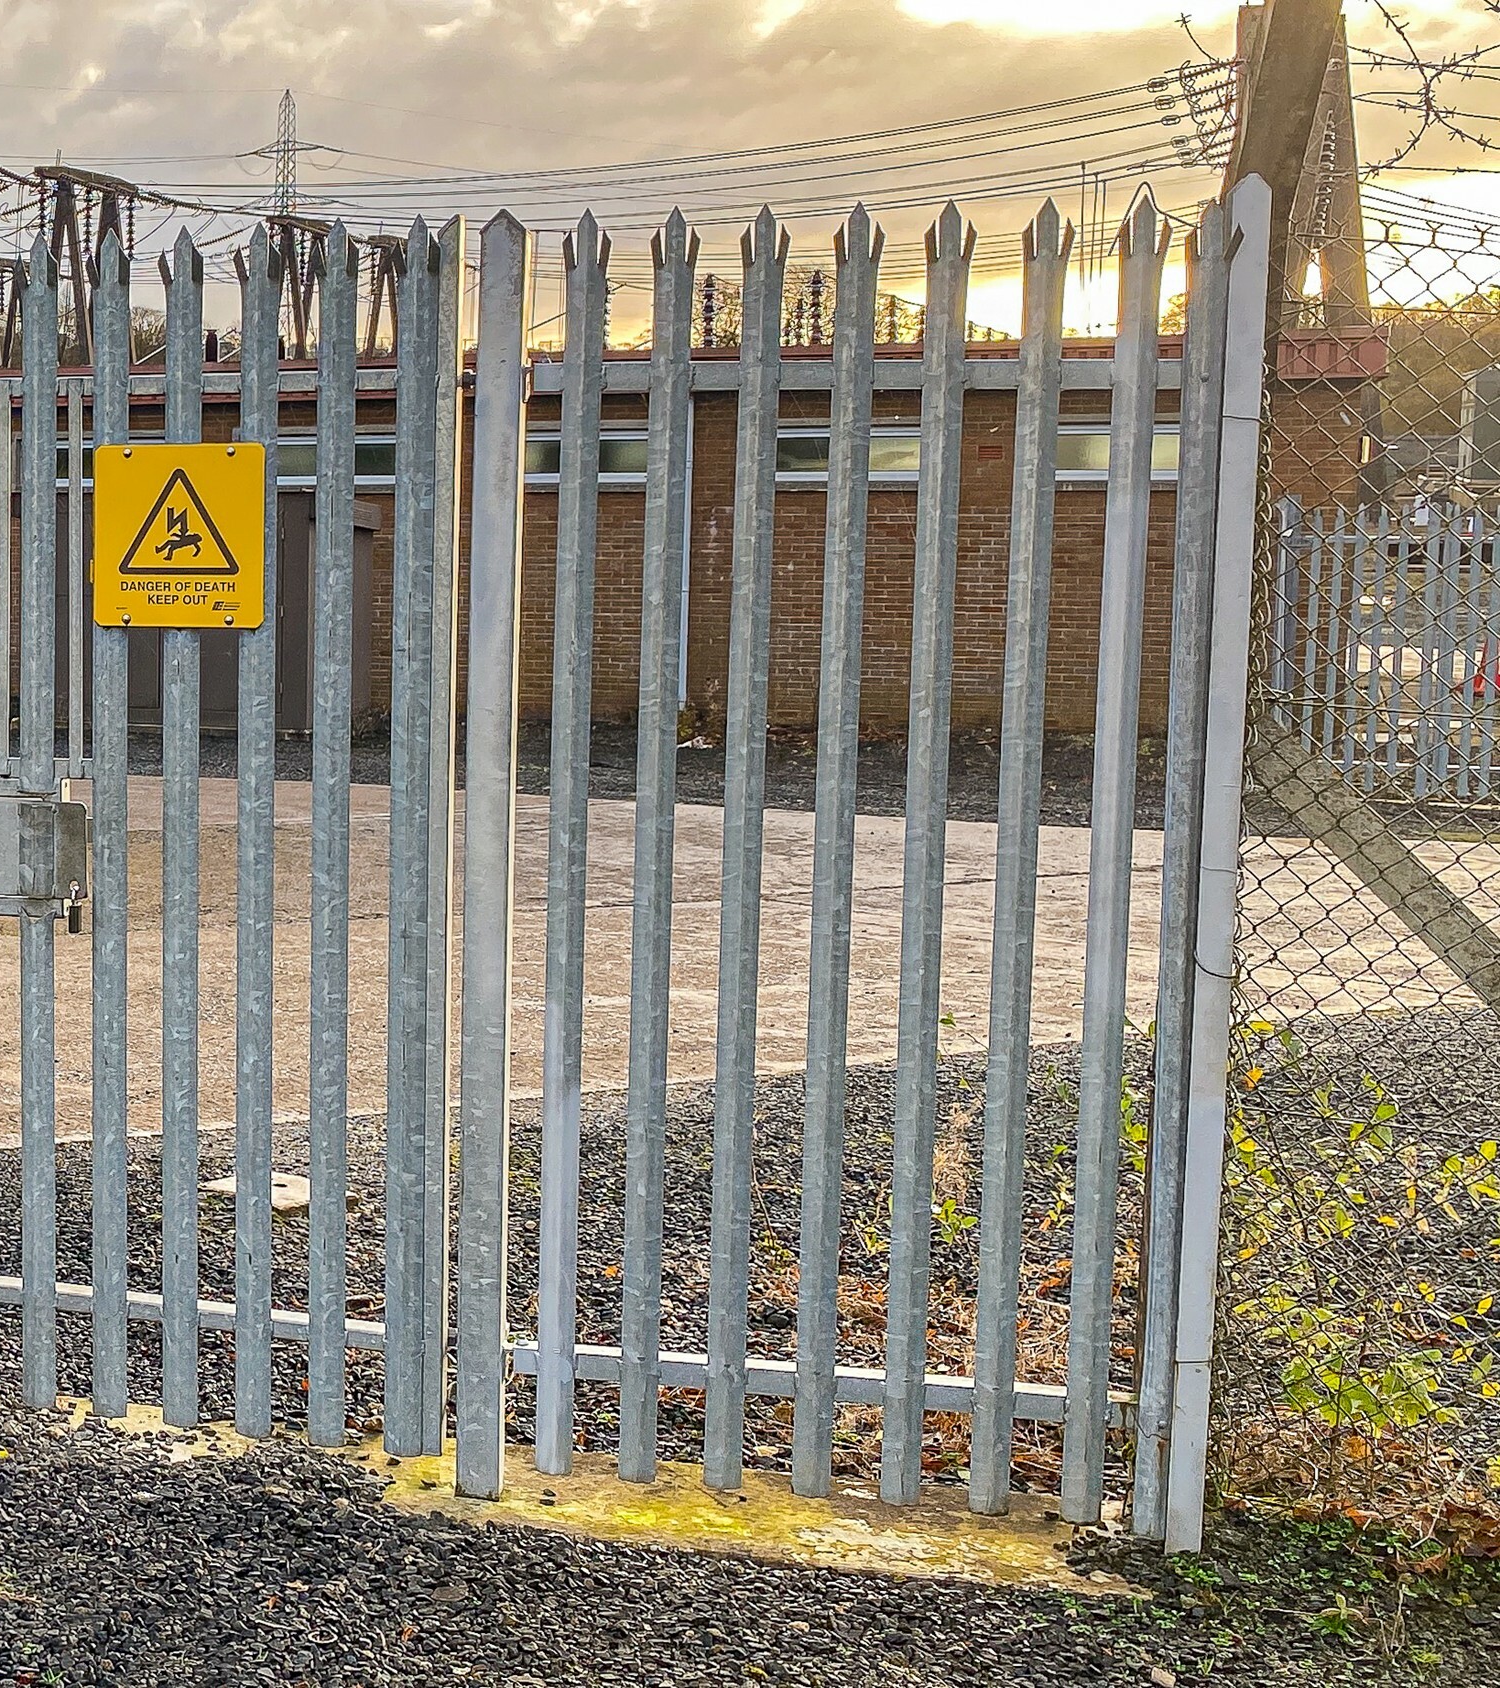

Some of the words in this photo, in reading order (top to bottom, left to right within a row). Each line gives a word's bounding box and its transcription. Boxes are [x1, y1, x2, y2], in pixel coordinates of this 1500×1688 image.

[120, 581, 171, 592] DANGER
[174, 581, 192, 592] OF
[194, 581, 236, 593] DEATH
[147, 594, 180, 605] KEEP
[182, 594, 209, 606] OUT
